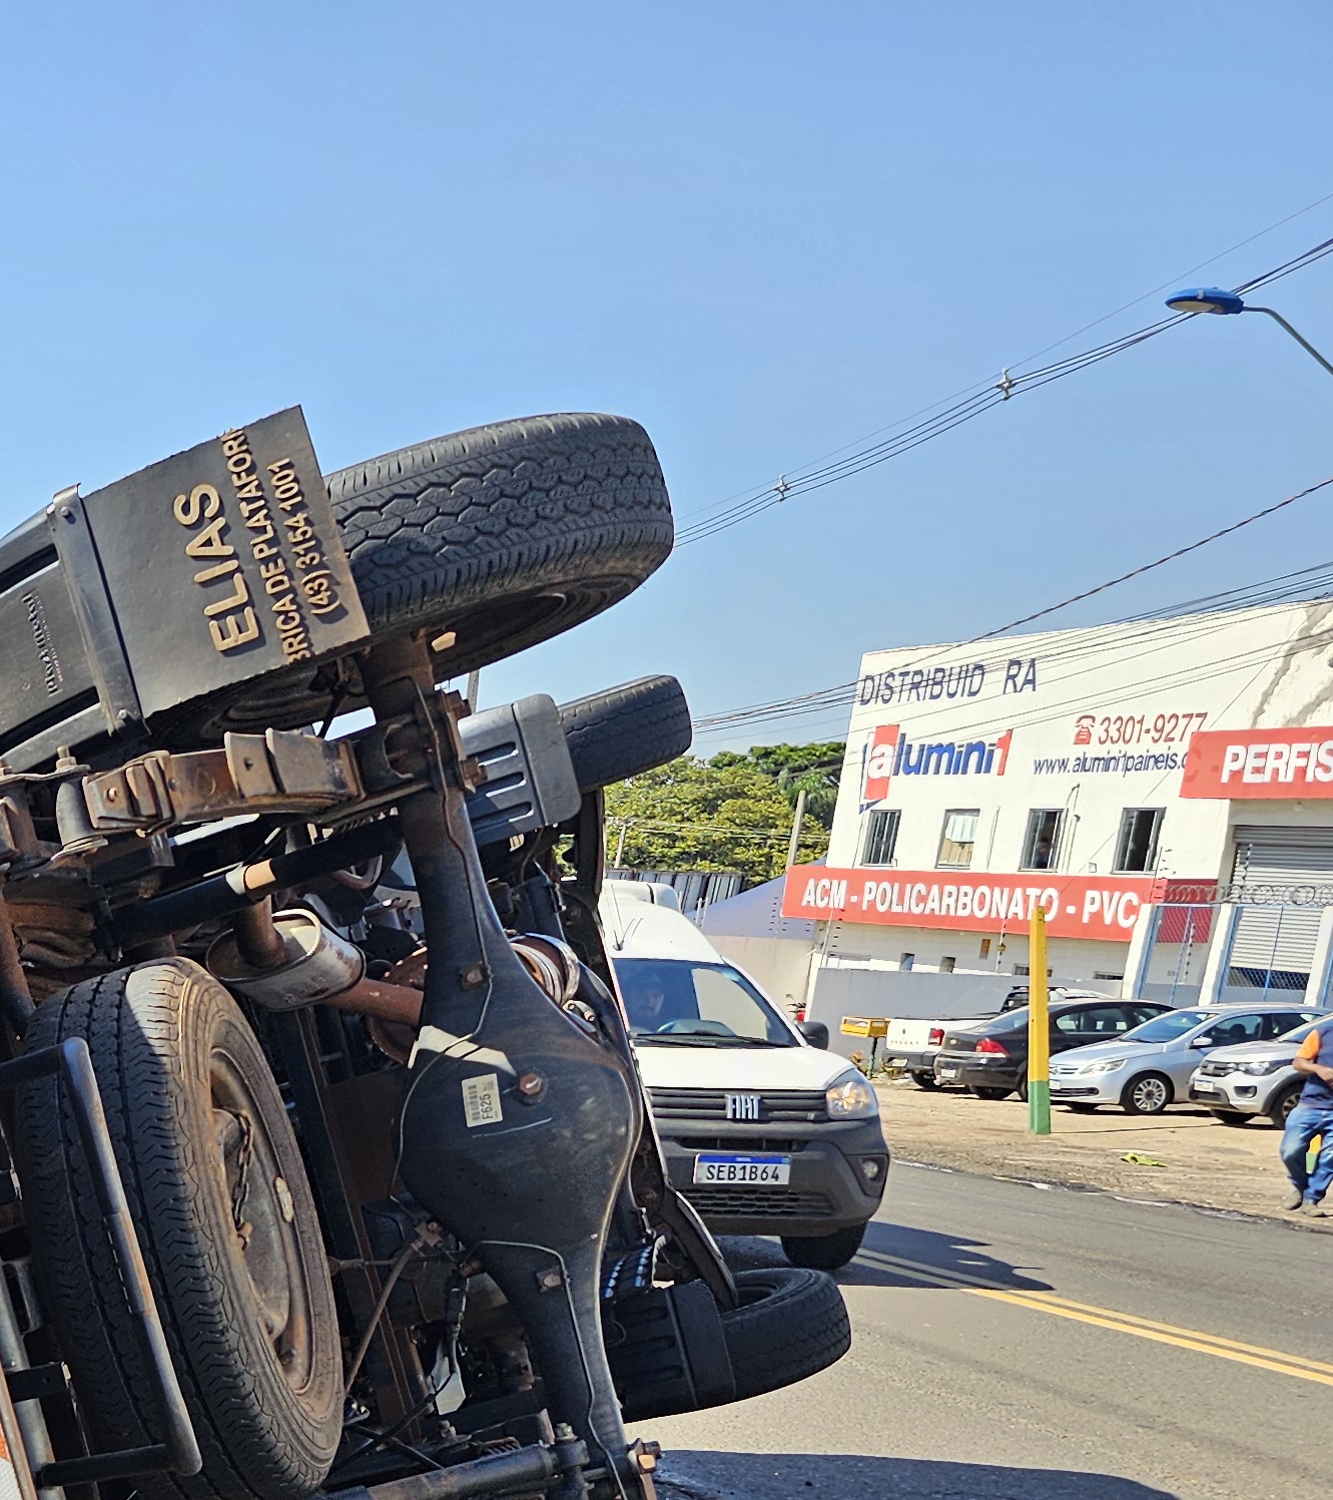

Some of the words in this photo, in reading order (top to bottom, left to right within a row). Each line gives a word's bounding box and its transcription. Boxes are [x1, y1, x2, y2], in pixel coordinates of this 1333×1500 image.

[267, 458, 302, 511] 1001
[284, 513, 320, 568] 3154
[173, 484, 259, 651] ELIAS
[260, 558, 290, 594] DE
[301, 569, 340, 614] (43)
[1098, 712, 1207, 745] 3301-9277
[1221, 740, 1333, 783] PERFIS
[801, 878, 847, 909] ACM
[862, 881, 1058, 922] POLICARBONATO
[1083, 890, 1139, 928] PVC
[479, 1094, 493, 1119] F625
[724, 1094, 761, 1119] FIAT
[706, 1165, 779, 1181] SEB1B64
